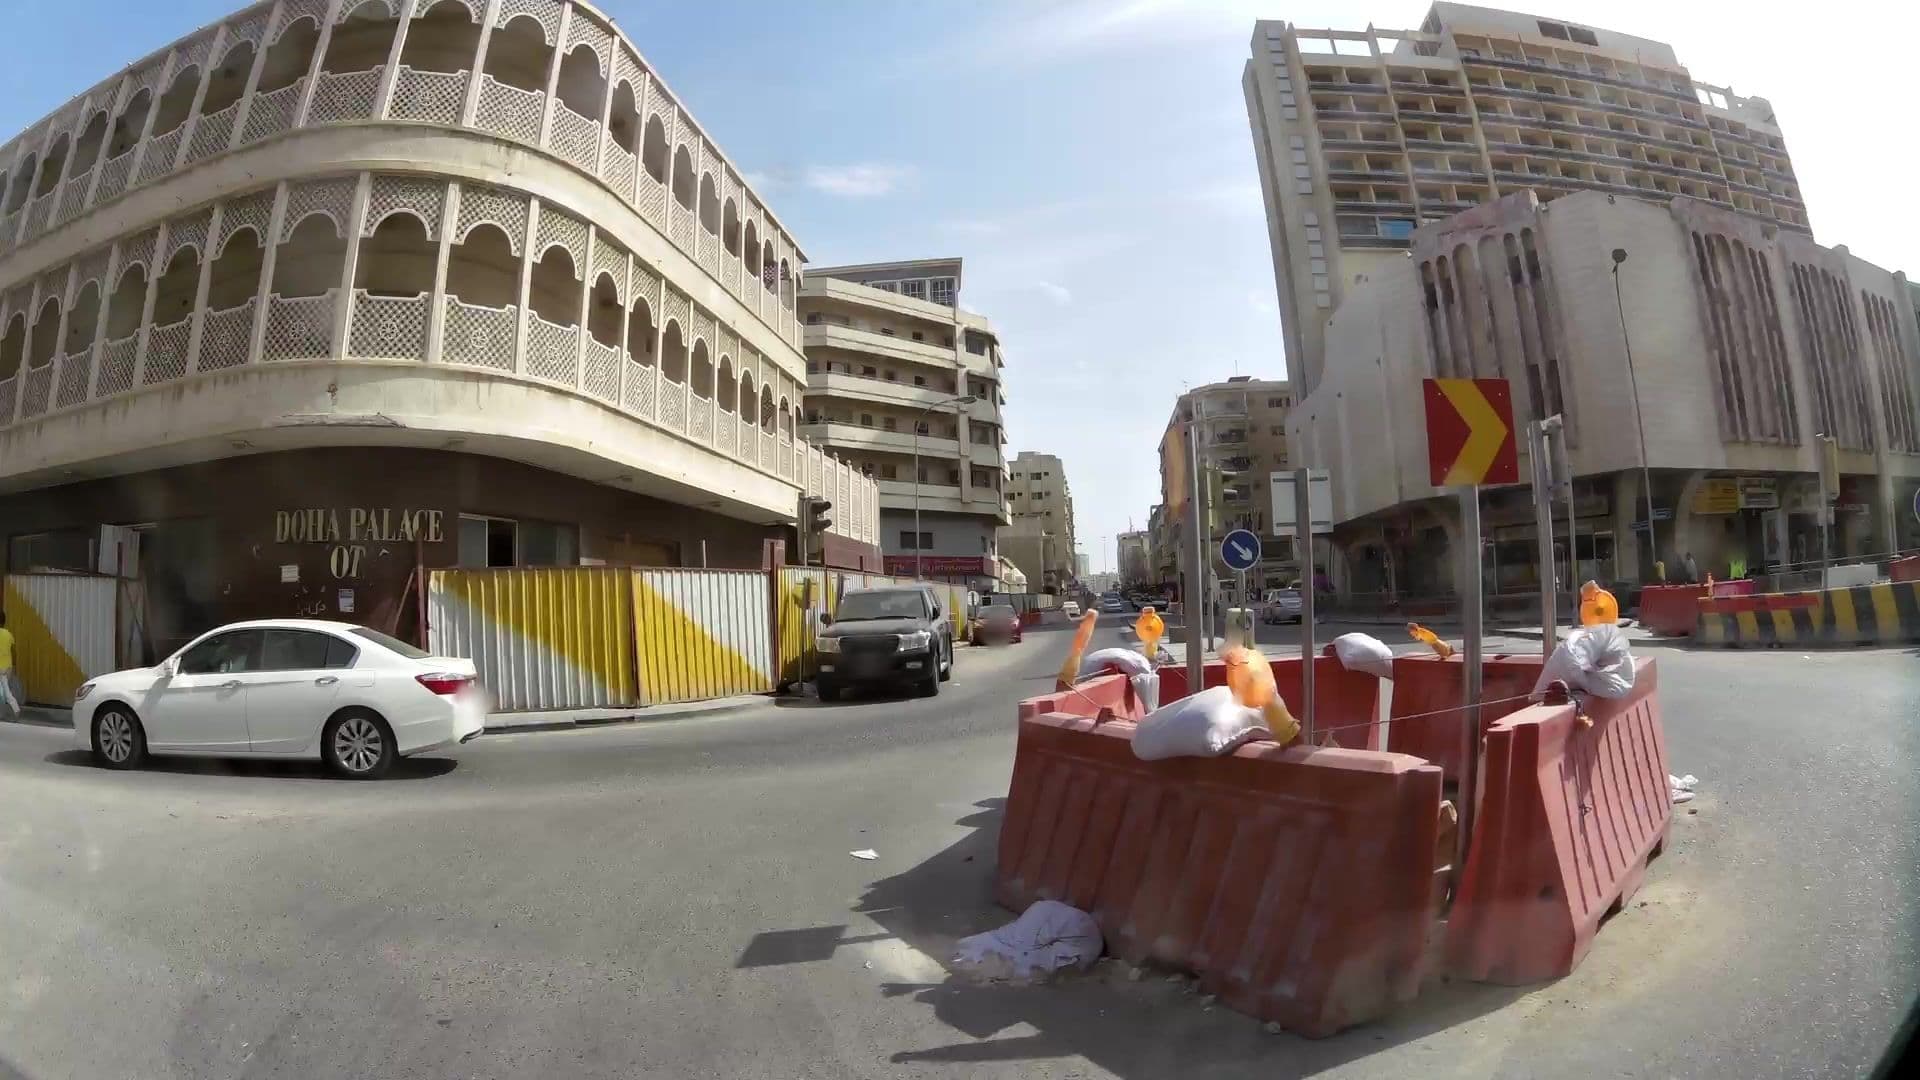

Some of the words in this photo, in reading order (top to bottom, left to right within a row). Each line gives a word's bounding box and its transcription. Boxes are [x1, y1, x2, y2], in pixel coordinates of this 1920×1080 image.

[275, 508, 340, 543] DOHA
[350, 507, 443, 542] PALACE
[330, 545, 366, 579] OT
